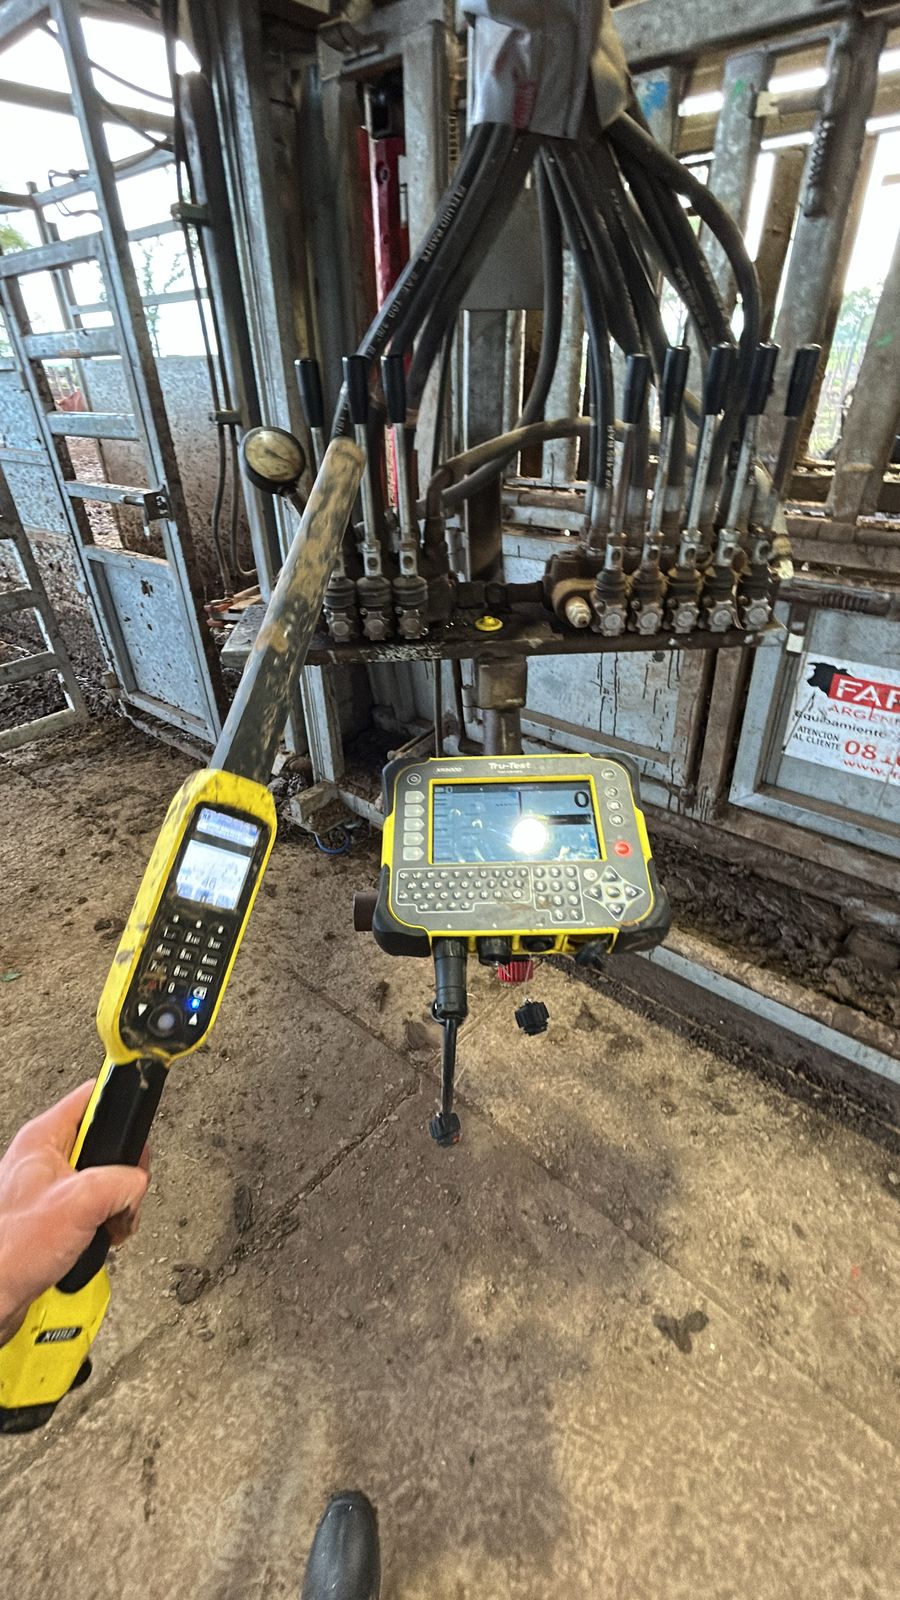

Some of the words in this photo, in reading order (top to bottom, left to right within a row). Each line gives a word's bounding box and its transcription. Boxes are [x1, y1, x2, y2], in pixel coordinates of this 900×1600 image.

[806, 734, 841, 751] CLIENTE
[488, 762, 530, 770] Tru-Test
[575, 791, 589, 808] 0
